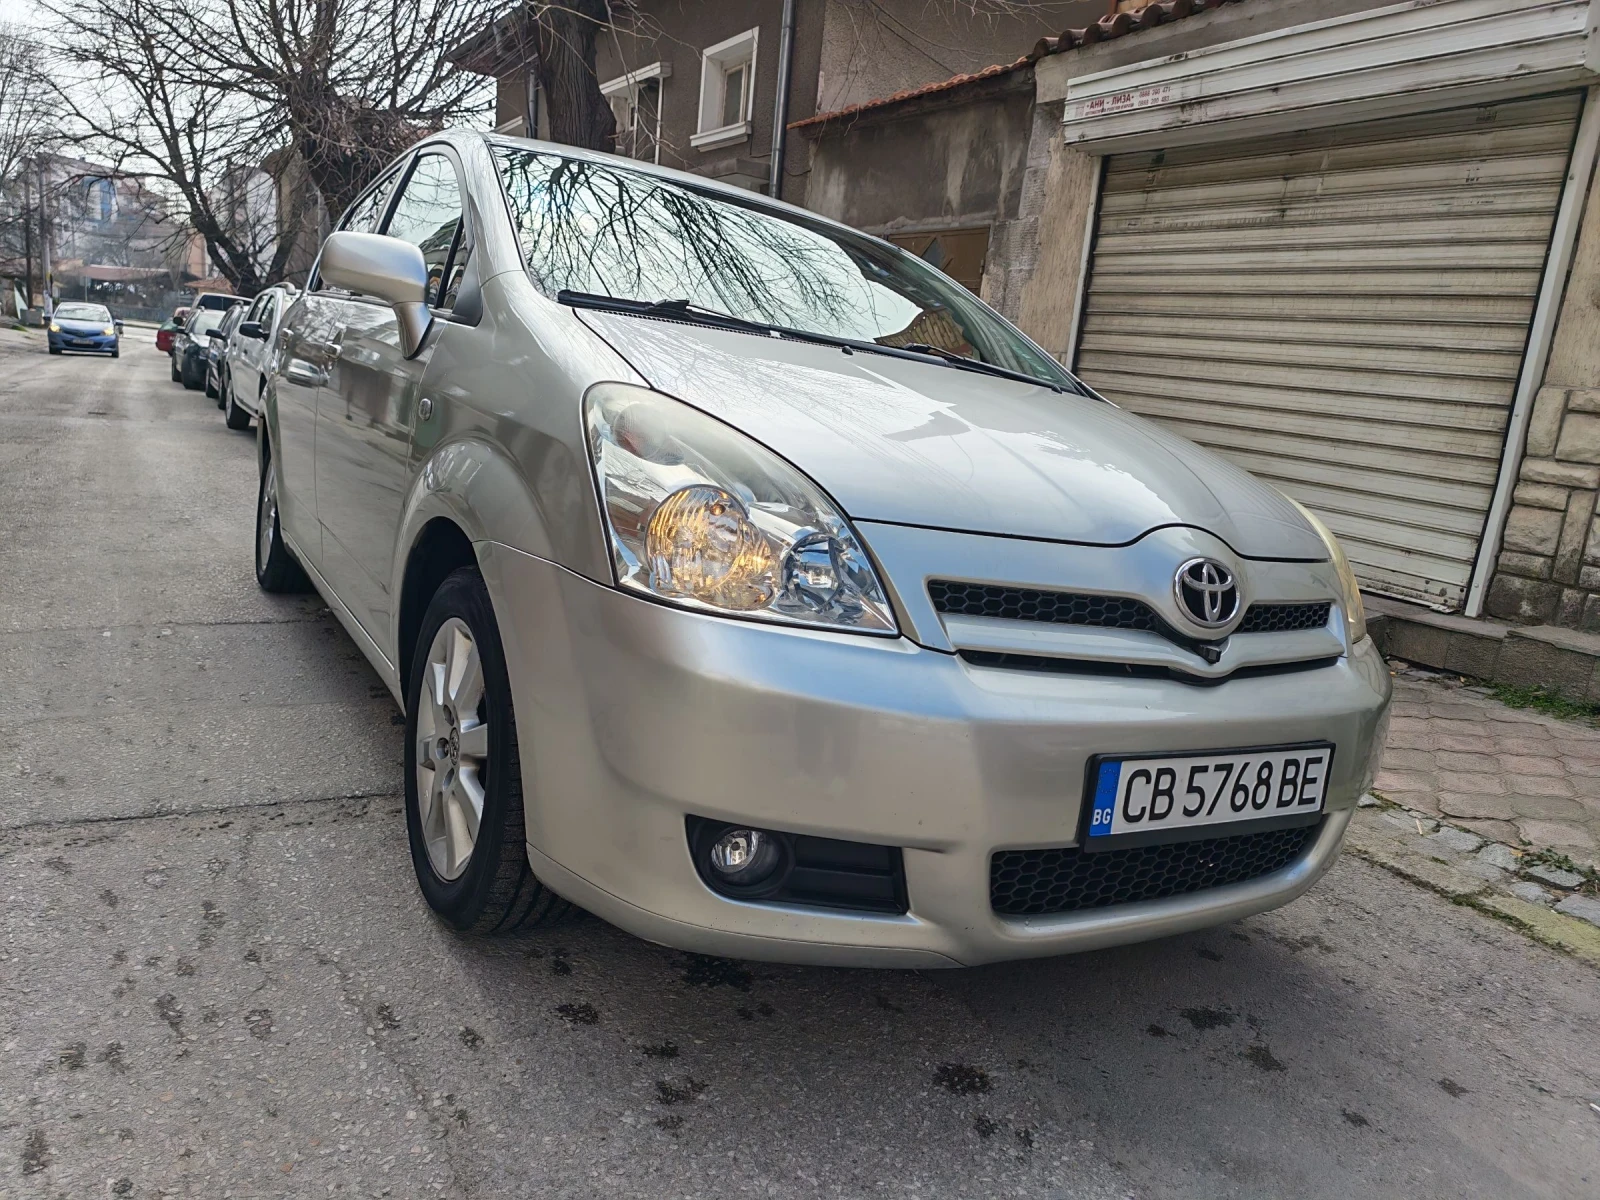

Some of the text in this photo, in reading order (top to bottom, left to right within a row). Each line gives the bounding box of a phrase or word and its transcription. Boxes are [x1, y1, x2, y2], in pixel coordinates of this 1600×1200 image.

[1122, 756, 1324, 823] CB 5768 BE
[1092, 808, 1111, 826] BG
